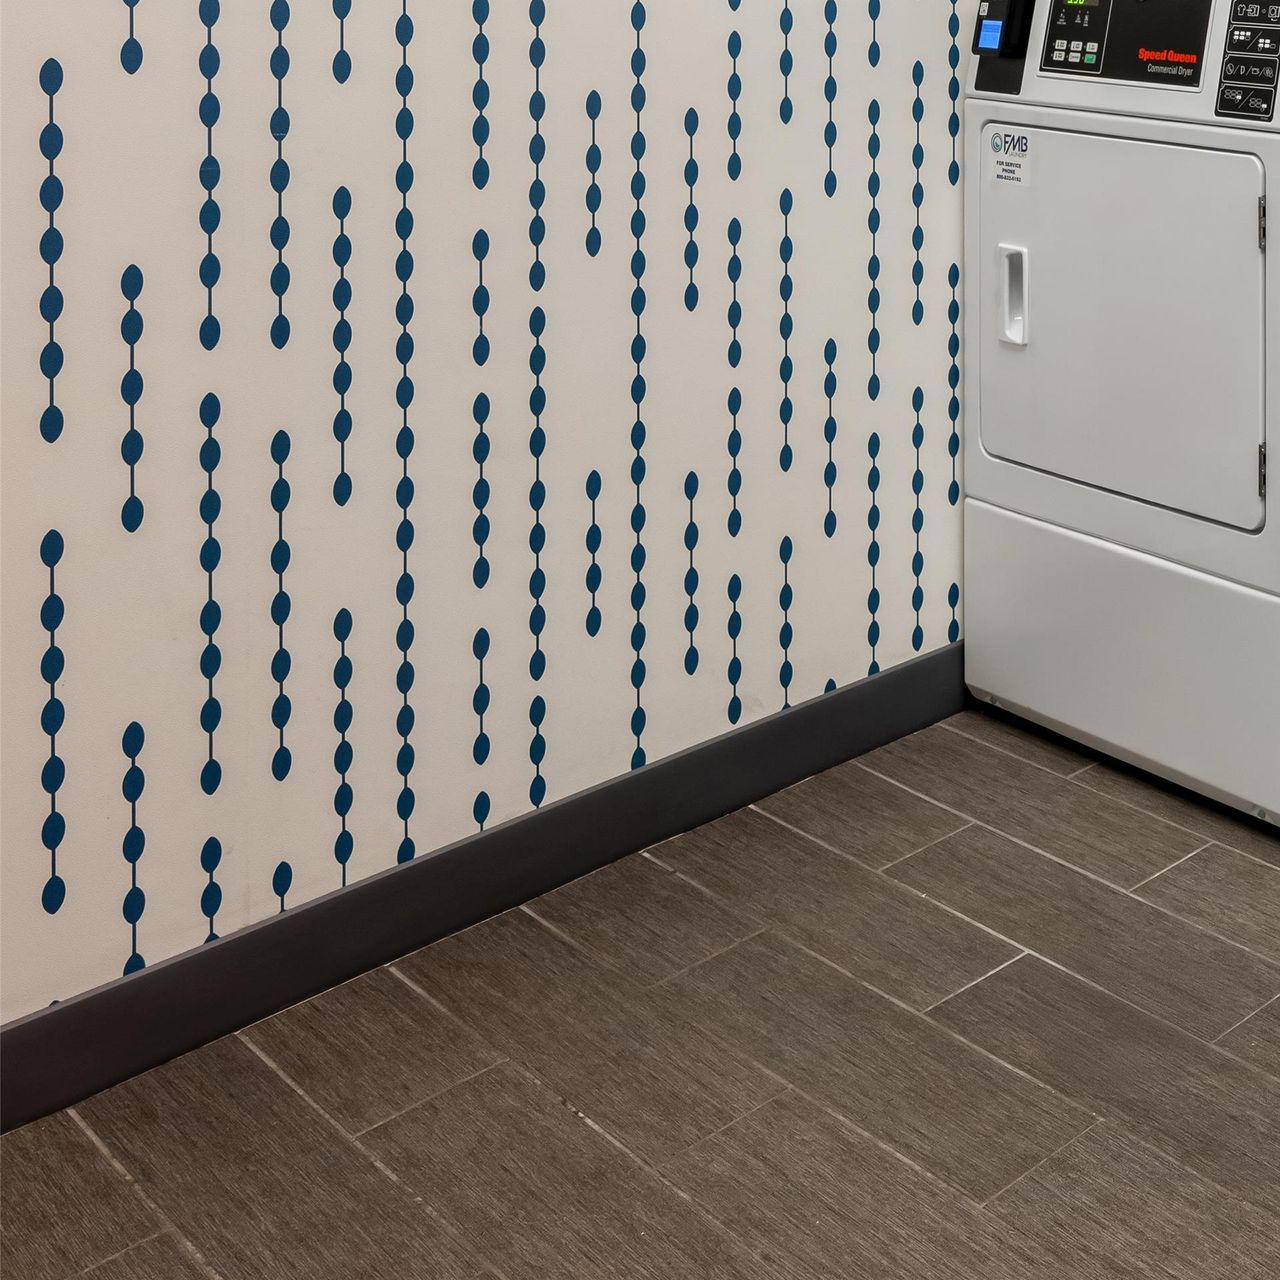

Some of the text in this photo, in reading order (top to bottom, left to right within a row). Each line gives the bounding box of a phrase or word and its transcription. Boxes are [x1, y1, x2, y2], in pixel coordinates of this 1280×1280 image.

[1138, 48, 1197, 63] Speed Queen
[1147, 63, 1193, 77] Commercial Dryer
[1004, 134, 1028, 155] FMB
